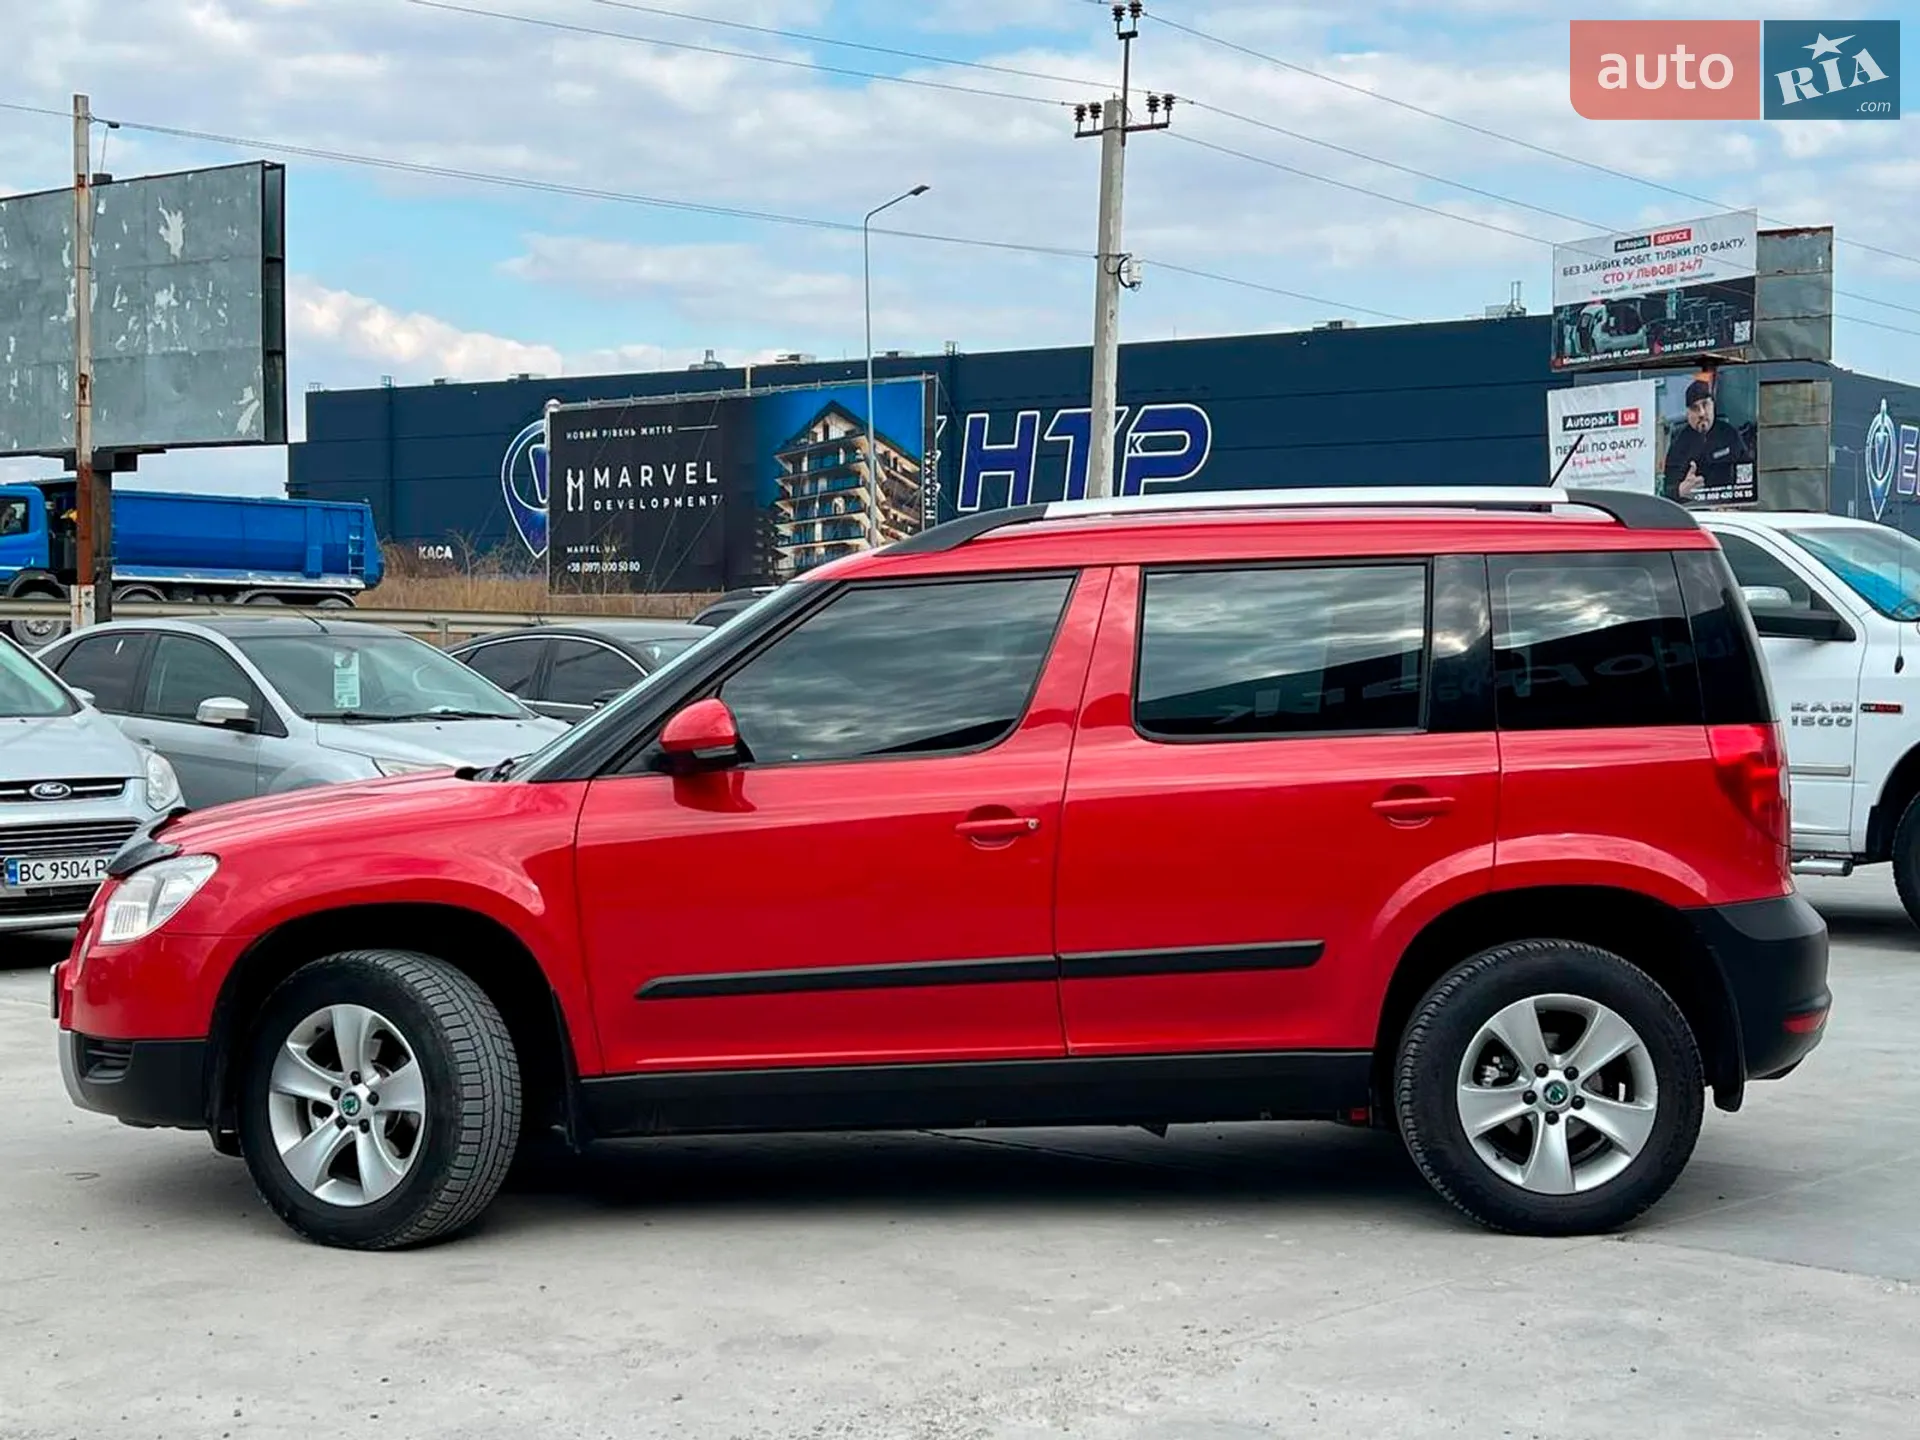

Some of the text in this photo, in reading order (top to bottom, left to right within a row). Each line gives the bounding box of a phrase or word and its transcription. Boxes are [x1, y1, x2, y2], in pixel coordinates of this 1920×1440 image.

[1655, 231, 1688, 244] SERVICE
[1563, 265, 1580, 277] БЕЗ
[1582, 258, 1621, 273] ЗАЙВИХ
[1655, 246, 1691, 260] ТІЛЬКИ
[1693, 243, 1708, 255] ПО
[1603, 271, 1624, 284] СТО
[1627, 269, 1634, 281] У
[1636, 263, 1678, 279] ЛЬВОВІ
[1680, 258, 1703, 272] 24/7
[1565, 412, 1616, 429] Autopark
[566, 428, 598, 440] НОВИЙ
[602, 427, 636, 438] РІВЕНЬ
[1591, 441, 1608, 453] ПО
[1609, 438, 1647, 452] ФАКТУ.
[593, 461, 718, 490] MARVEL
[594, 494, 719, 511] DEVELOPMENT
[20, 863, 45, 882] BC
[49, 860, 90, 880] 9504
